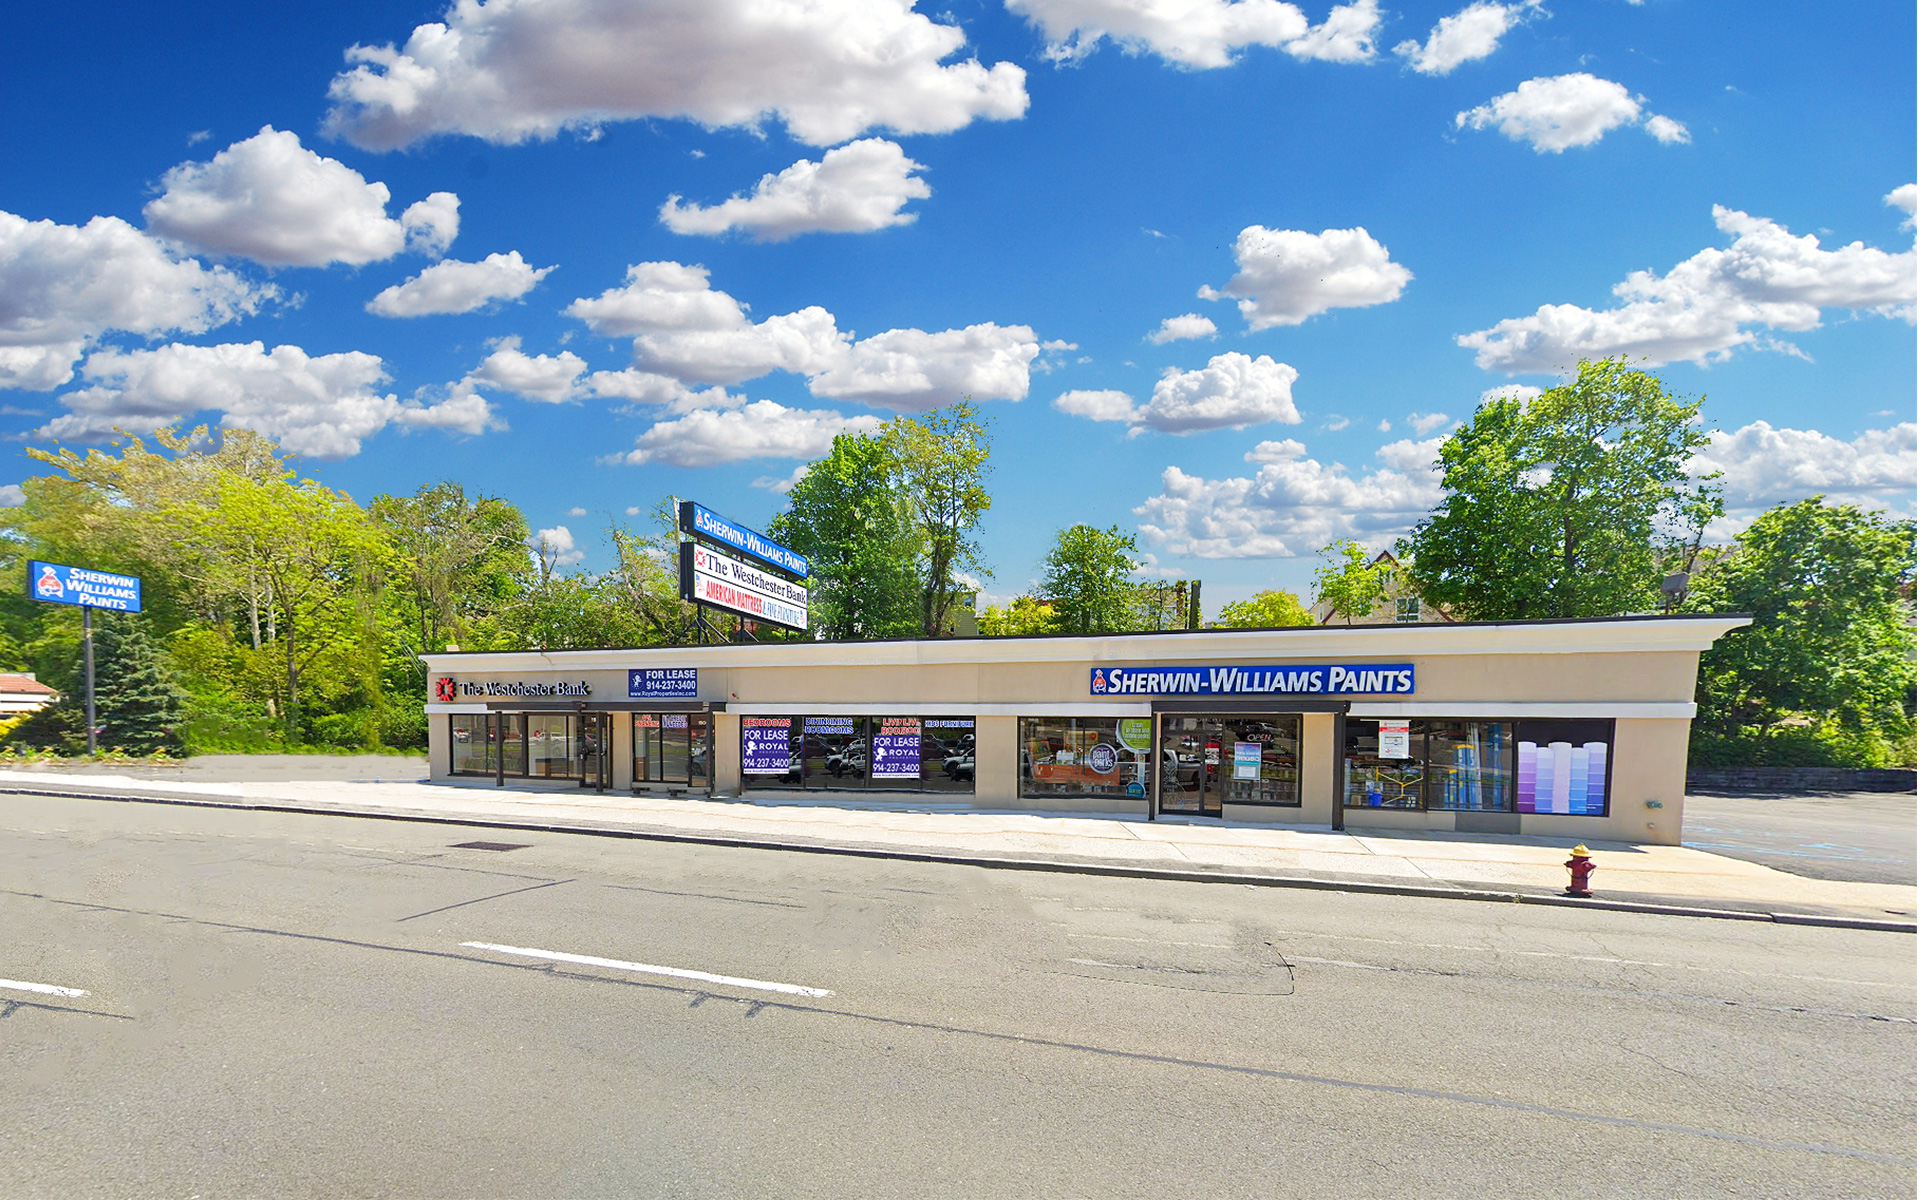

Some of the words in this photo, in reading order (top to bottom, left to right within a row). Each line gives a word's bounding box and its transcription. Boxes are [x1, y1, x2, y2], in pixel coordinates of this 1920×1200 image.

[703, 512, 784, 564] SHERWIN-WILLIAMS
[784, 551, 807, 574] PAINTS
[69, 568, 134, 588] SHERWIN
[706, 553, 728, 576] The
[731, 562, 786, 596] Westchester
[786, 584, 806, 604] Bank
[66, 579, 136, 599] WILLIAMS
[79, 593, 127, 609] PAINTS
[706, 580, 736, 606] AMERICAN
[737, 591, 762, 614] MATTRESS
[646, 670, 664, 679] FOR
[667, 670, 696, 679] LEASE
[1108, 668, 1322, 693] SHERWIN-WILLIAMS
[1328, 666, 1412, 692] PAINTS
[460, 683, 482, 696] The
[485, 682, 553, 696] Westchester
[556, 681, 589, 695] Bank
[646, 681, 696, 690] 914-237-3400
[743, 719, 791, 727] BEDROOMS
[744, 730, 761, 740] FOR
[763, 730, 788, 740] LEASE
[1247, 733, 1271, 742] OPEN
[874, 738, 891, 746] FOR
[893, 738, 919, 746] LEASE
[1092, 750, 1110, 760] paint
[743, 758, 789, 767] 914-237-3400
[873, 763, 920, 772] 914-237-3400
[1094, 759, 1113, 768] perks
